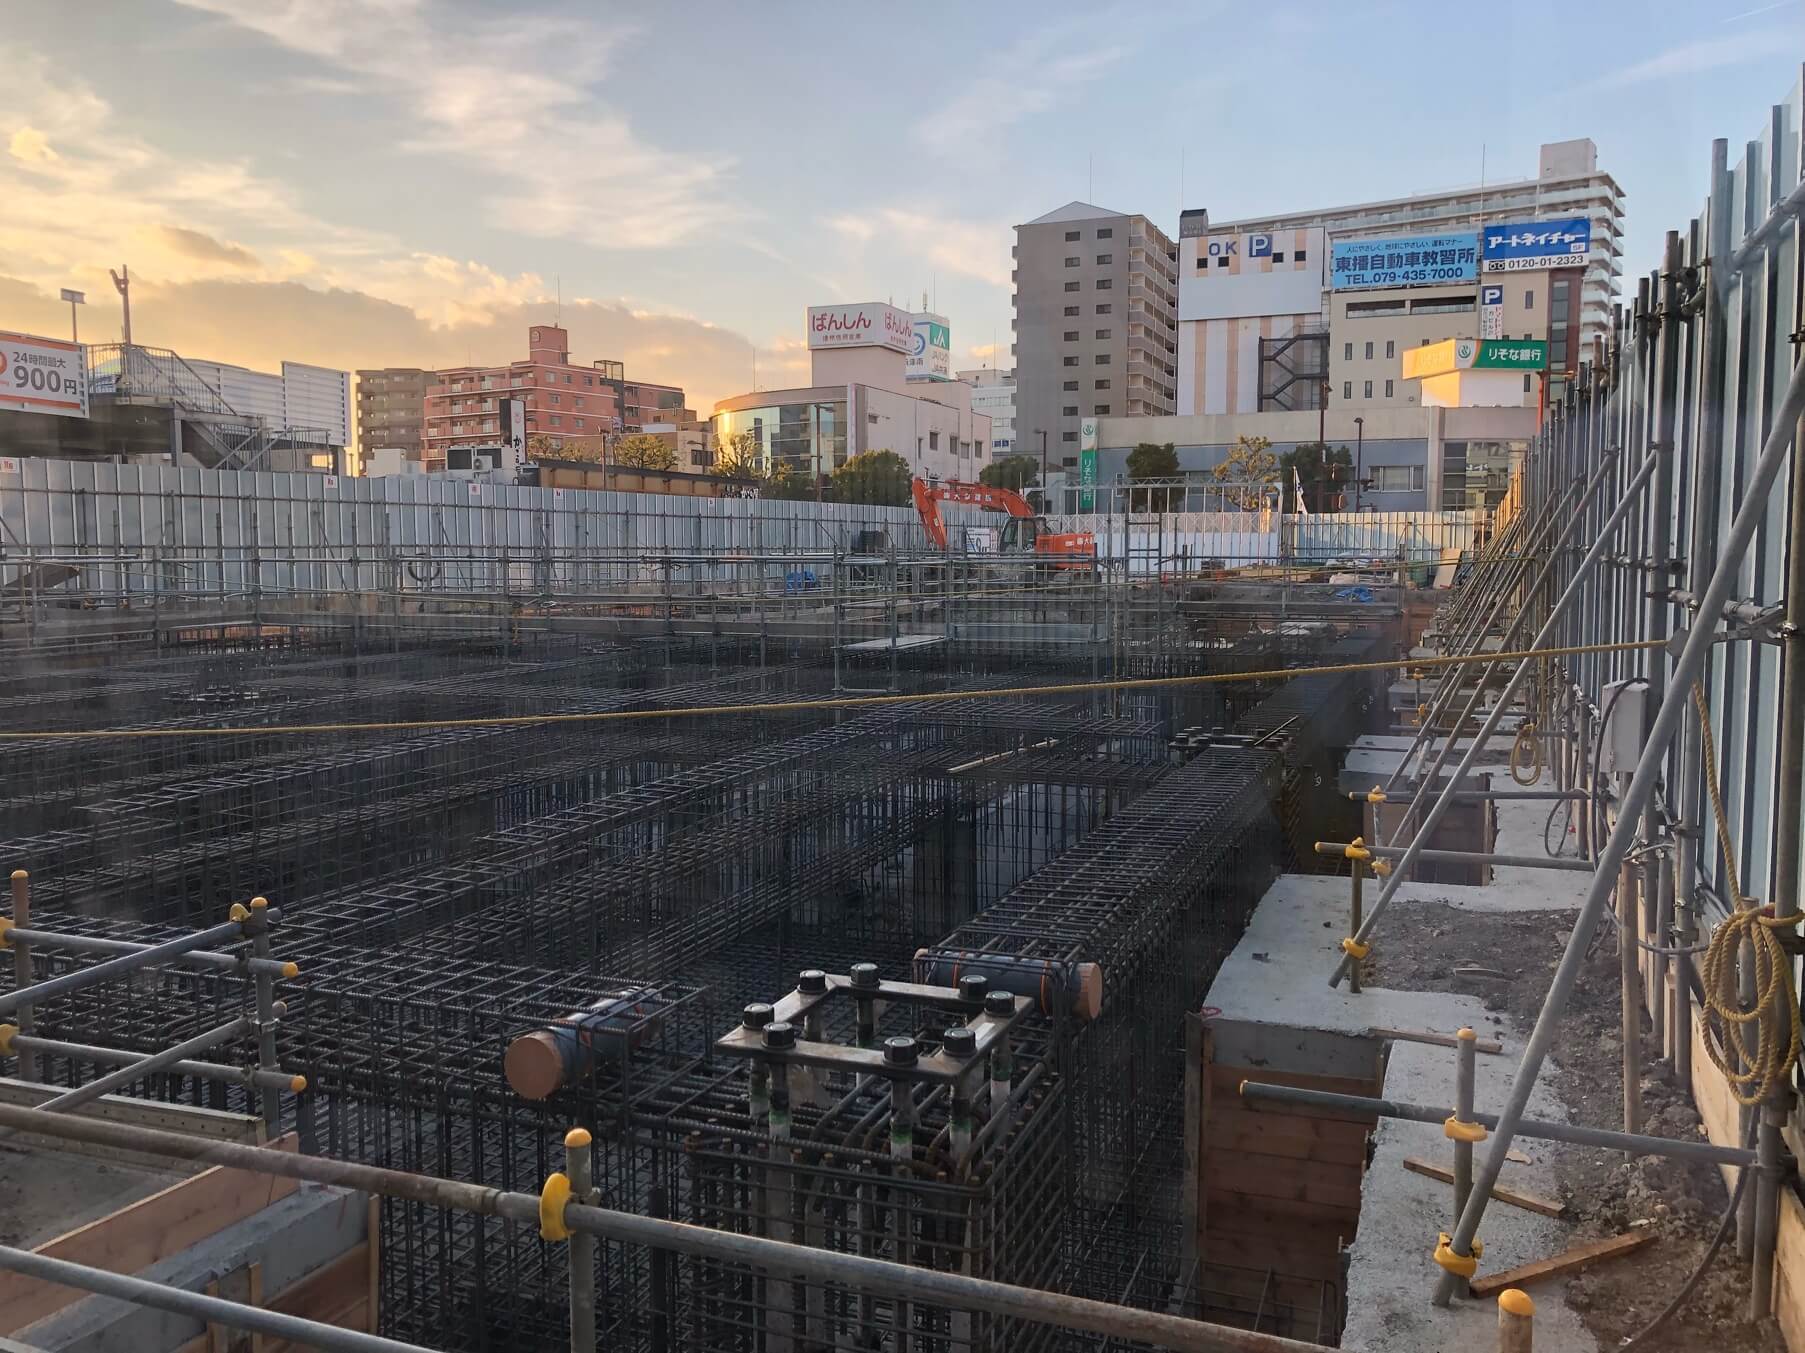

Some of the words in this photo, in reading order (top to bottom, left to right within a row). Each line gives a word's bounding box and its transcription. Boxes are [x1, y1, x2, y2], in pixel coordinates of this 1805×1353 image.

[1209, 241, 1237, 256] OK
[1252, 236, 1269, 256] P
[1487, 232, 1586, 249] アートネイチャー
[1335, 247, 1475, 273] 東播自動車教習所
[1508, 254, 1584, 269] 0120-01-2323
[1484, 289, 1500, 304] P
[812, 311, 872, 332] ばんしん
[884, 312, 912, 338] ばんしん
[13, 351, 67, 369] 24時間最大
[1488, 348, 1542, 361] りそな銀行
[13, 365, 77, 395] 900円
